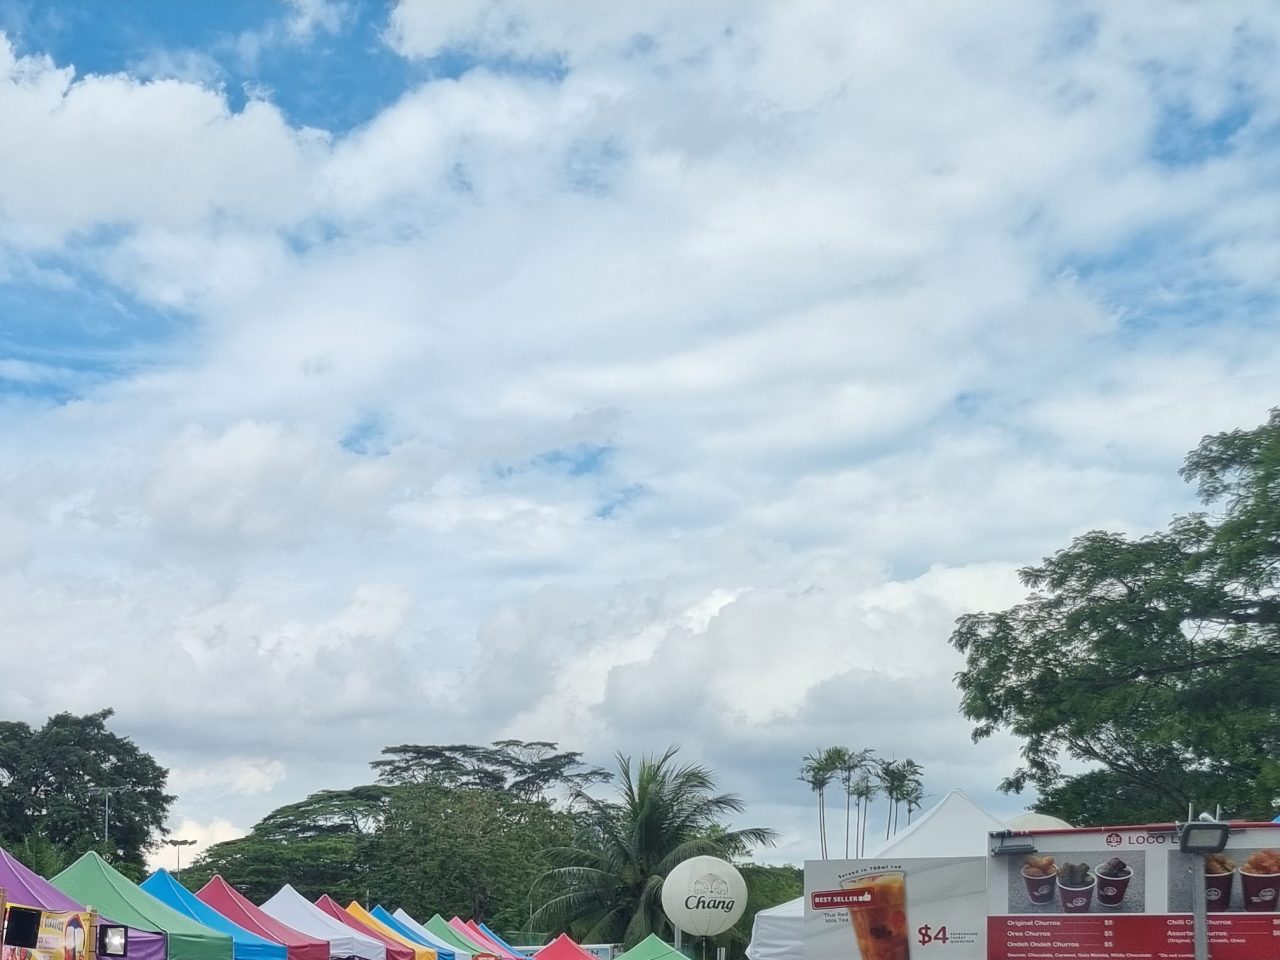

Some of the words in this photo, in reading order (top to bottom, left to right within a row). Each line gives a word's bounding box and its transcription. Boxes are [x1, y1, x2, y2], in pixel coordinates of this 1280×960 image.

[1128, 835, 1166, 845] LOCO
[684, 895, 735, 913] Chang
[814, 896, 832, 904] BEST
[833, 894, 858, 903] SELLER
[918, 924, 949, 946] $4
